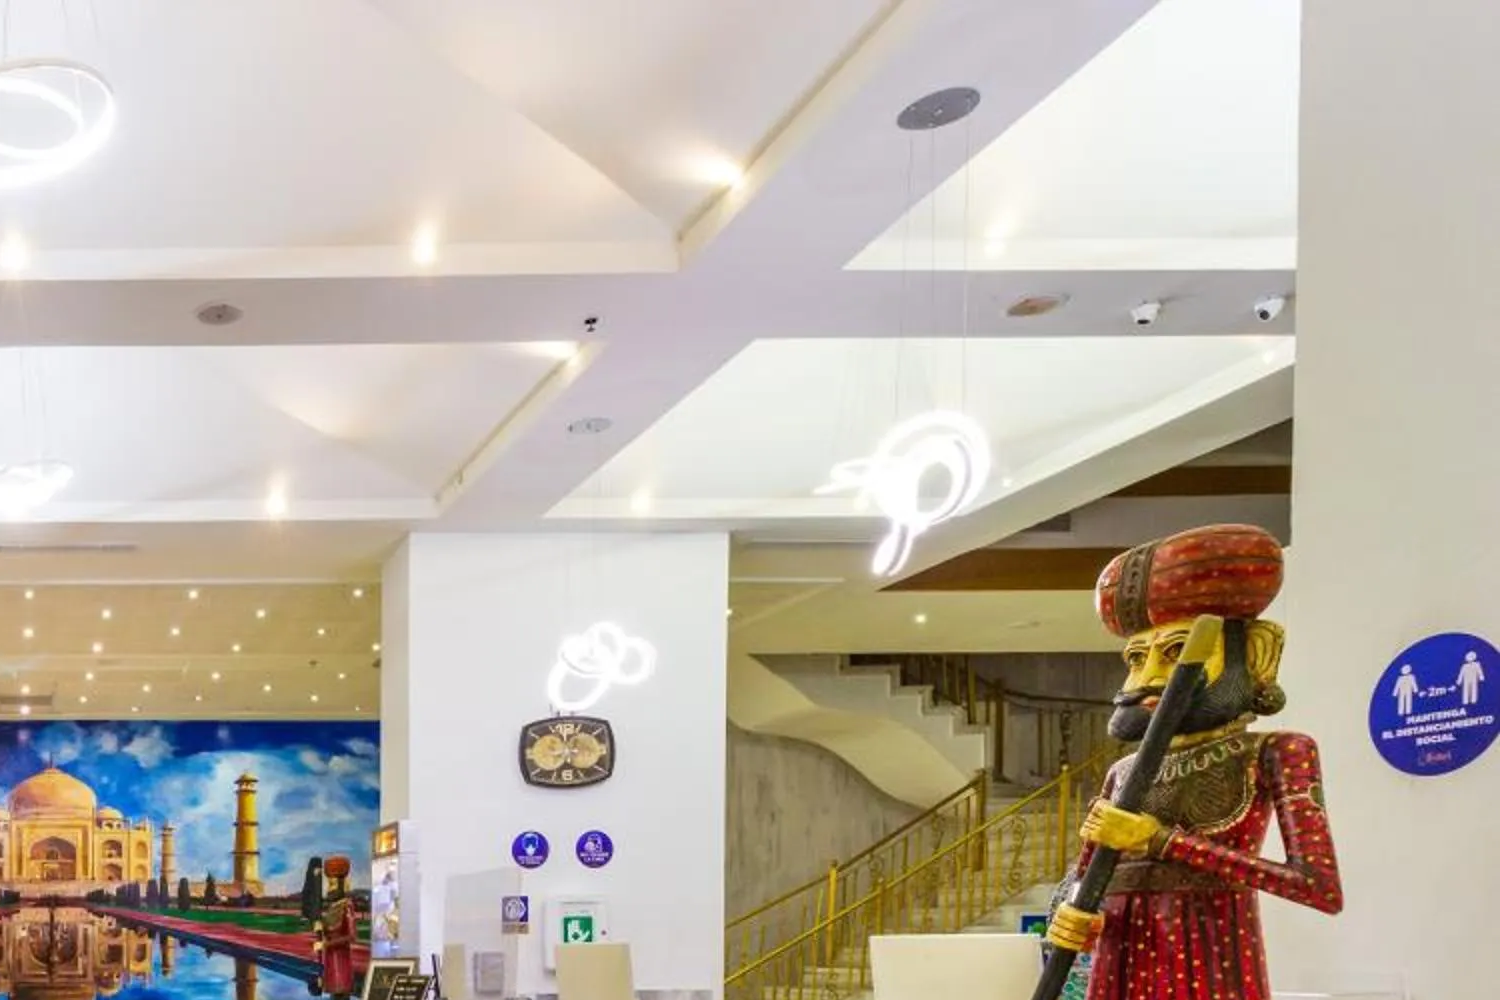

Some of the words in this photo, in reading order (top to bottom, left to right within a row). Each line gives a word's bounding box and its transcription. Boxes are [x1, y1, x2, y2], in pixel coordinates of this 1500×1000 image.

[1427, 687, 1447, 697] 2m
[1405, 707, 1467, 725] MANTENGA
[1381, 730, 1395, 740] EL
[1396, 715, 1494, 737] DISTANCIAMIENTO
[1416, 733, 1456, 746] SOCIAL
